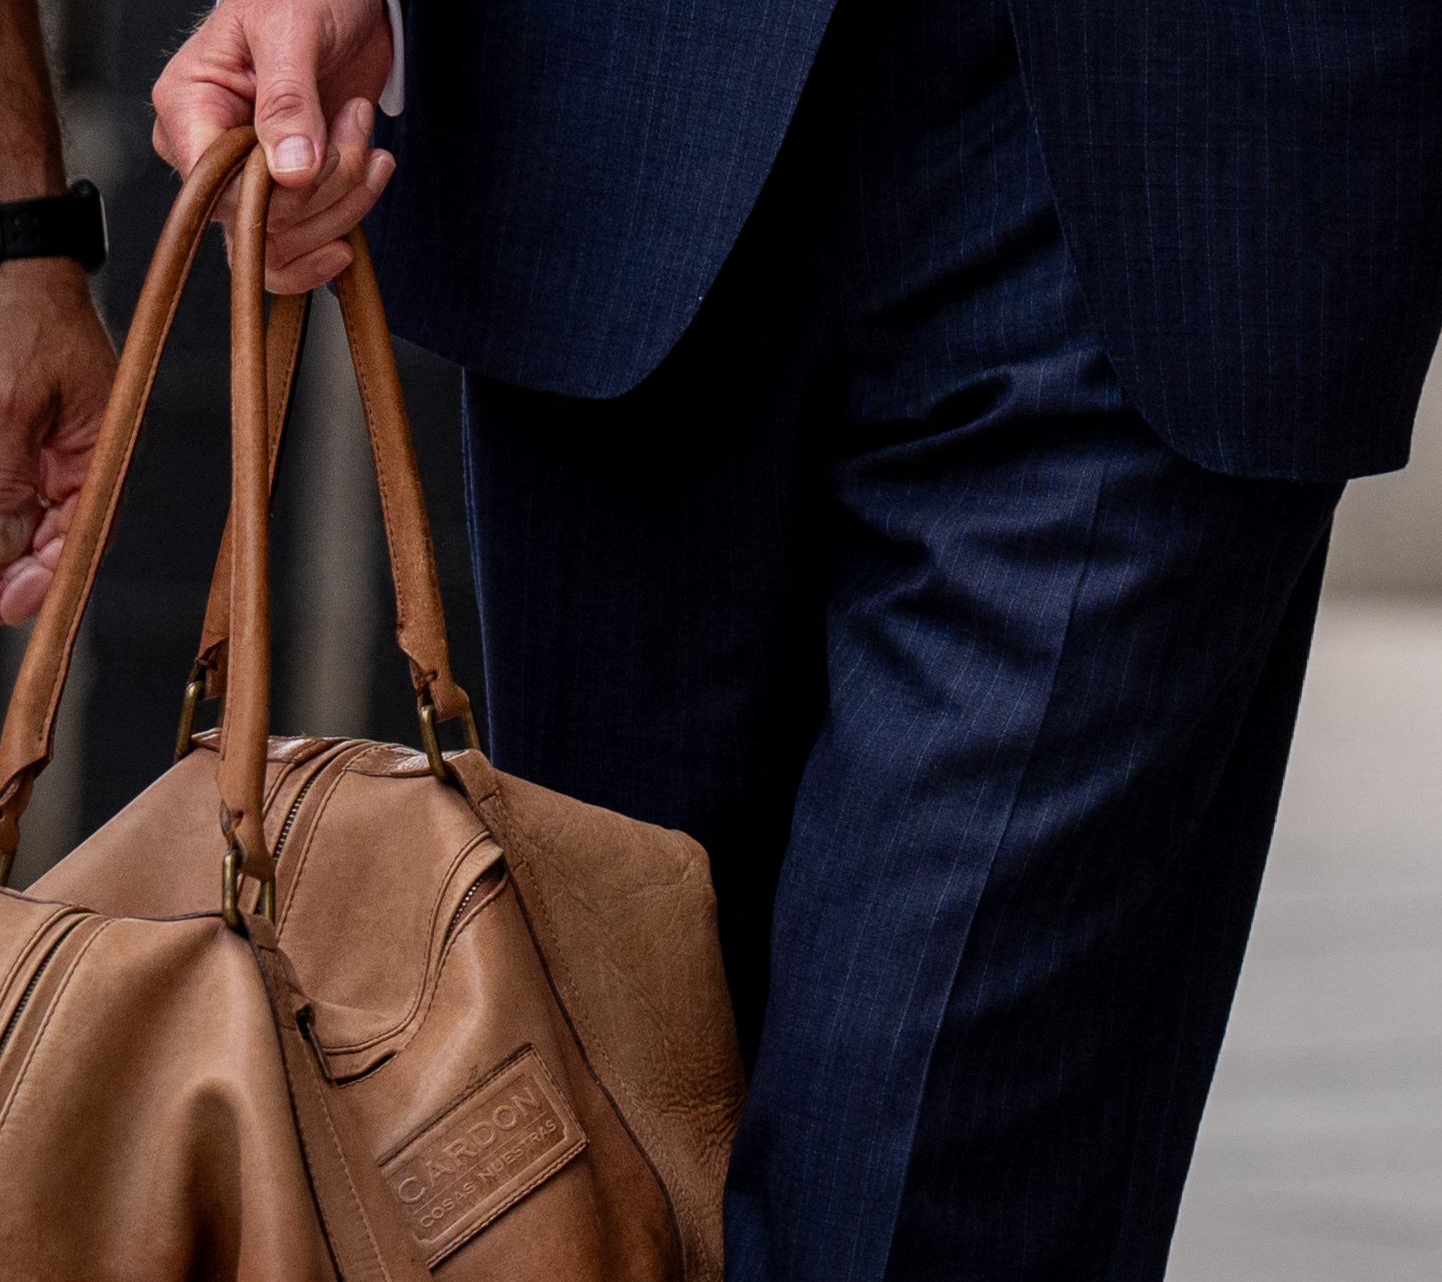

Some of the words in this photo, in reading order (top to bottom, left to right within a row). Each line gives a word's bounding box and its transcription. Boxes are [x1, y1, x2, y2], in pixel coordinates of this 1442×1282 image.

[397, 1085, 542, 1205] CARDON
[419, 1180, 477, 1229] COSAS
[477, 1118, 558, 1184] NUESTRAS
